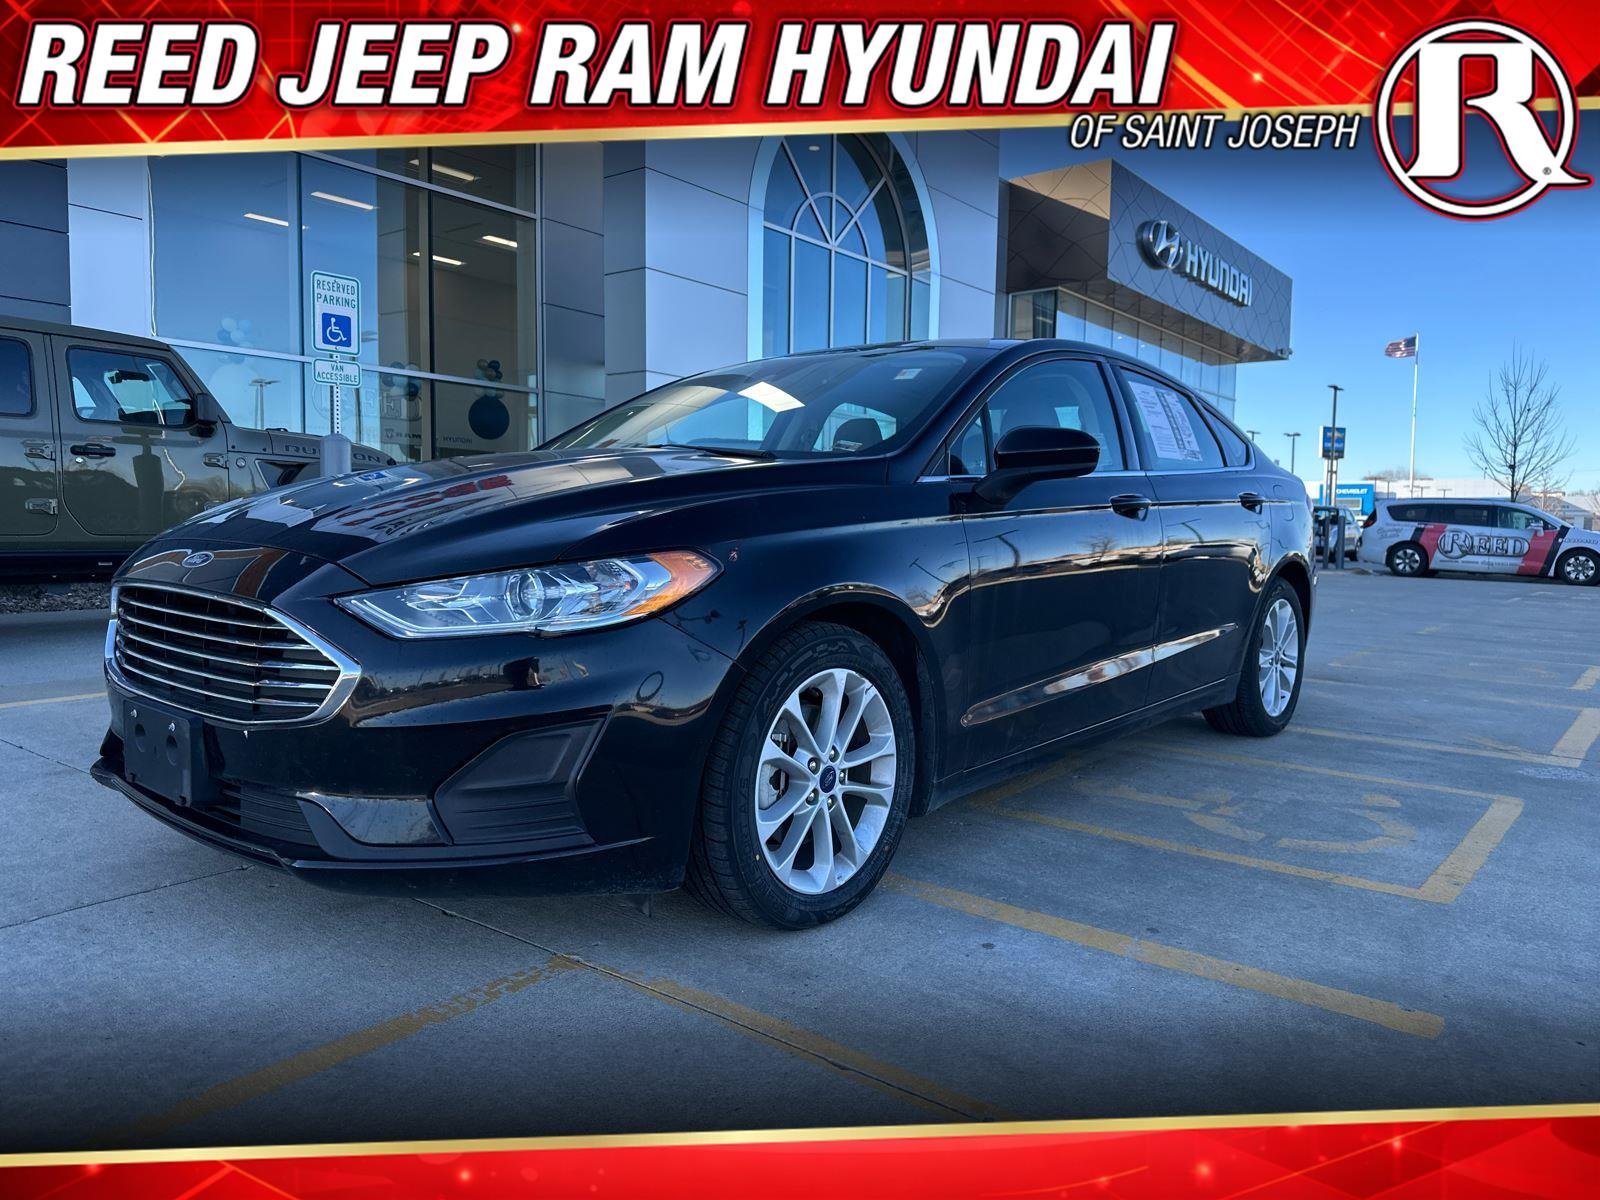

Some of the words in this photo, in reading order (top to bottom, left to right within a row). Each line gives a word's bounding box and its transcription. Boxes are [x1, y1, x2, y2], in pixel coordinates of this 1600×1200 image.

[1185, 239, 1253, 306] HYUNDAI
[316, 279, 356, 296] RESERVED
[316, 292, 356, 309] PARKING
[330, 363, 344, 372] VAN
[316, 371, 358, 383] ACCESSIBLE
